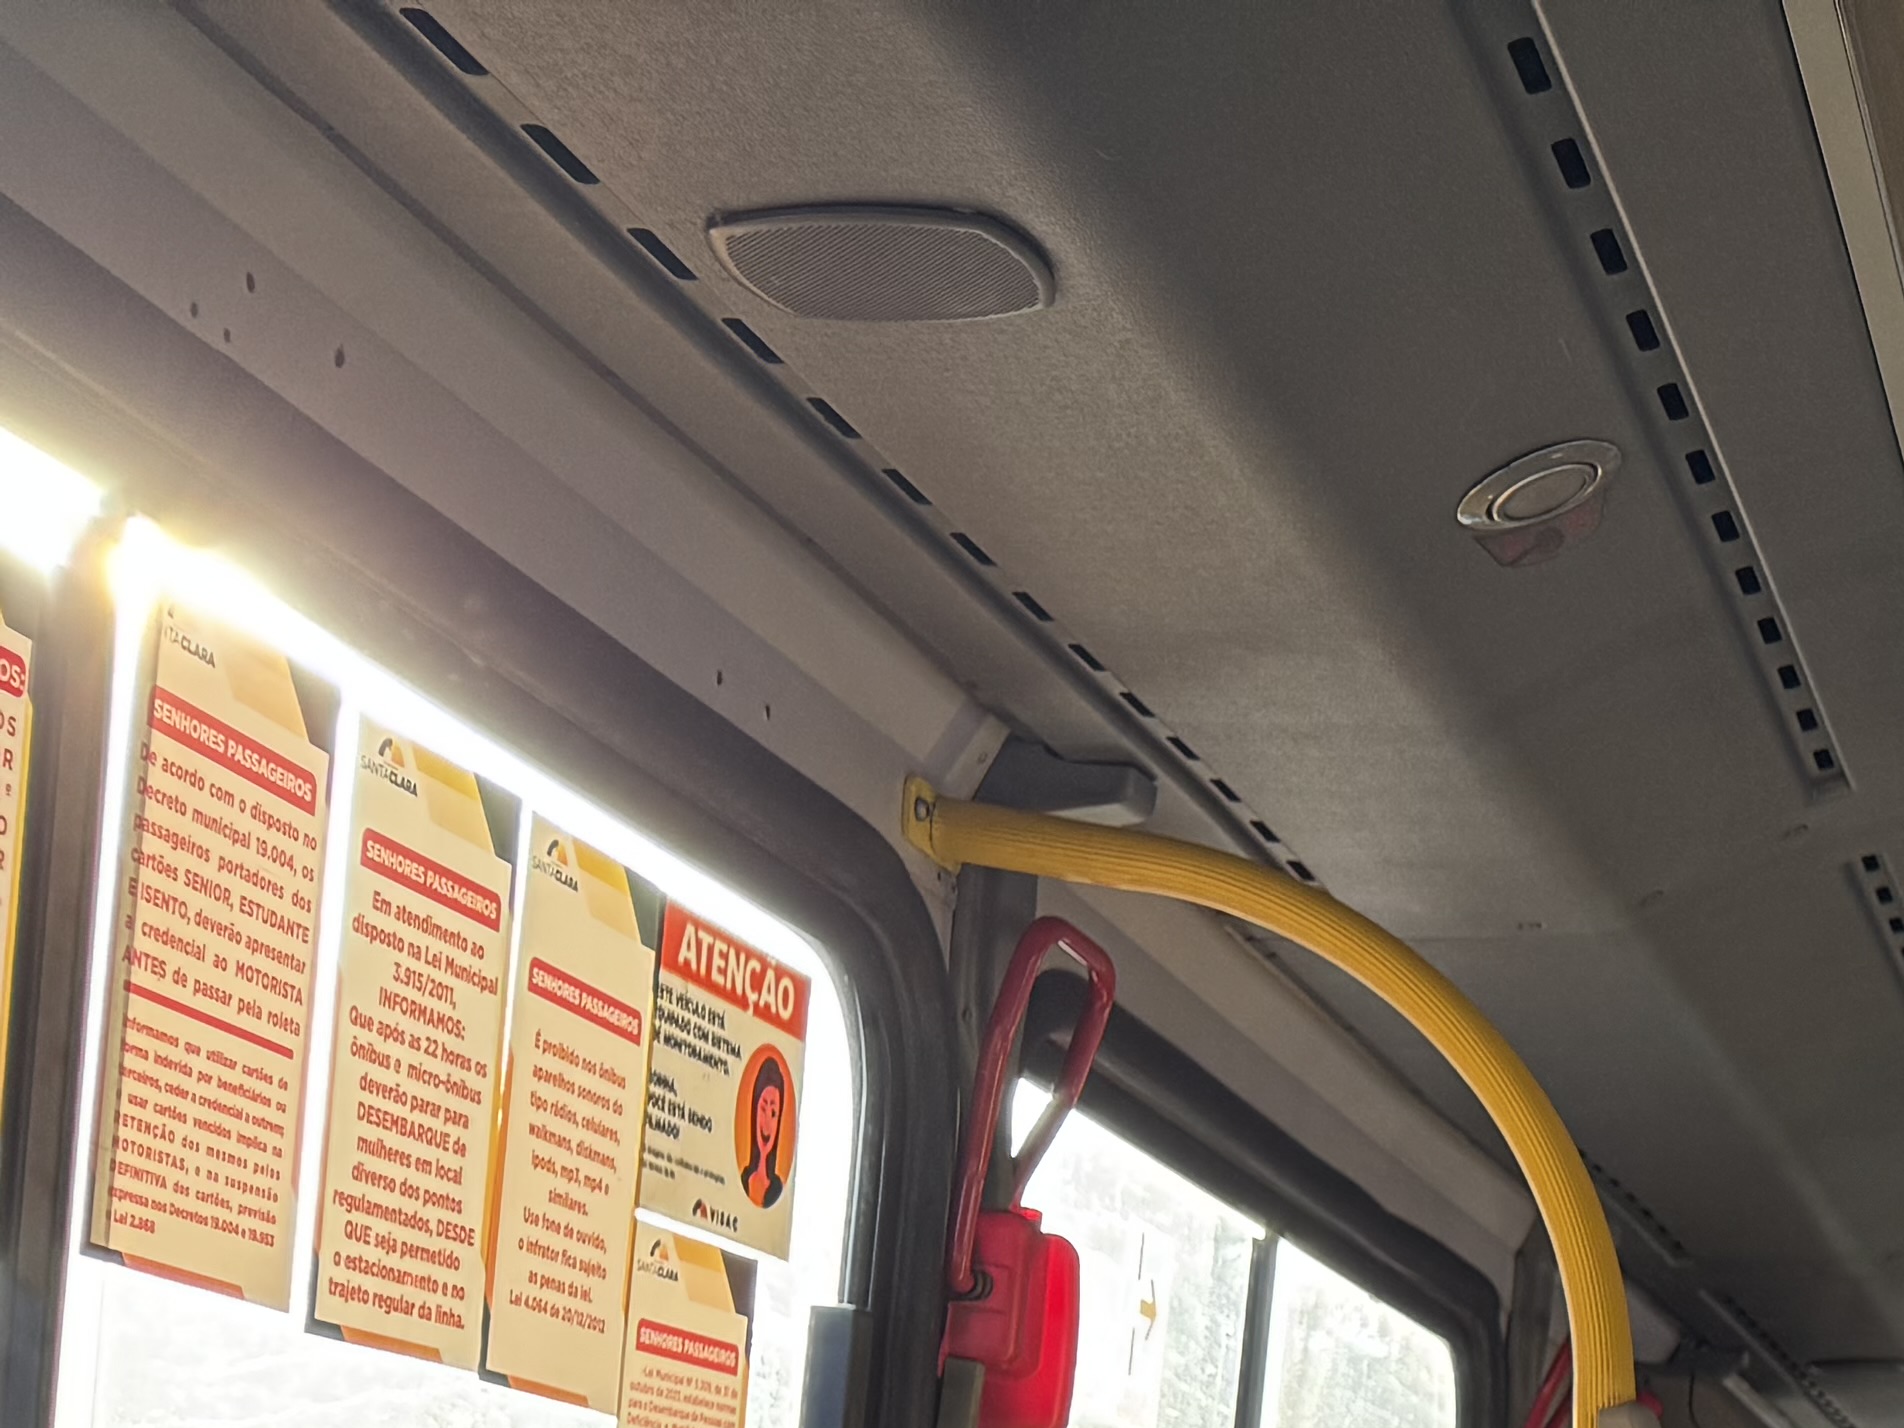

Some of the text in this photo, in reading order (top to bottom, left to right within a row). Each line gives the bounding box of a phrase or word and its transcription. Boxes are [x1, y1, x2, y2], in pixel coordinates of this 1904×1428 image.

[152, 697, 312, 802] SENHORES PASSAGEIROS
[136, 775, 315, 883] Decreto municipal 19.004, os
[139, 741, 318, 852] De acordo com o disposto no
[130, 847, 310, 945] cartões SENIOR, ESTUDANTE
[132, 813, 312, 914] passageiros portadores dos
[365, 839, 498, 919] SENHORES PASSAGEIROS
[139, 881, 191, 926] ISENTO,
[192, 907, 243, 946] deverão
[243, 933, 307, 975] apresentar
[351, 912, 499, 996] disposto na Lei Municipal
[371, 889, 485, 961] Em atendimento ao
[120, 944, 301, 1037] ANTES de passar pela roleta
[140, 920, 207, 963] credencial
[211, 952, 228, 973] ao
[233, 958, 303, 1007] MOTORISTA
[530, 966, 639, 1034] SENHORES PASSAGEIROS
[678, 920, 795, 1021] ATENÇÃO
[347, 1003, 488, 1079] Que após as 22 horas os
[377, 985, 466, 1041] INFORMAMOS:
[349, 1034, 482, 1106] ônibus e micro-ônibus
[357, 1070, 470, 1130] deverão parar para
[355, 1099, 467, 1158] DESEMBARQUE de
[355, 1134, 463, 1186] mulheres em local
[331, 1188, 476, 1248] regulamentados, DESDE
[350, 1160, 463, 1215] diverso dos pontos
[342, 1218, 373, 1246] QUE
[372, 1230, 398, 1256] seja
[327, 1275, 465, 1330] trajeto regular da linha.
